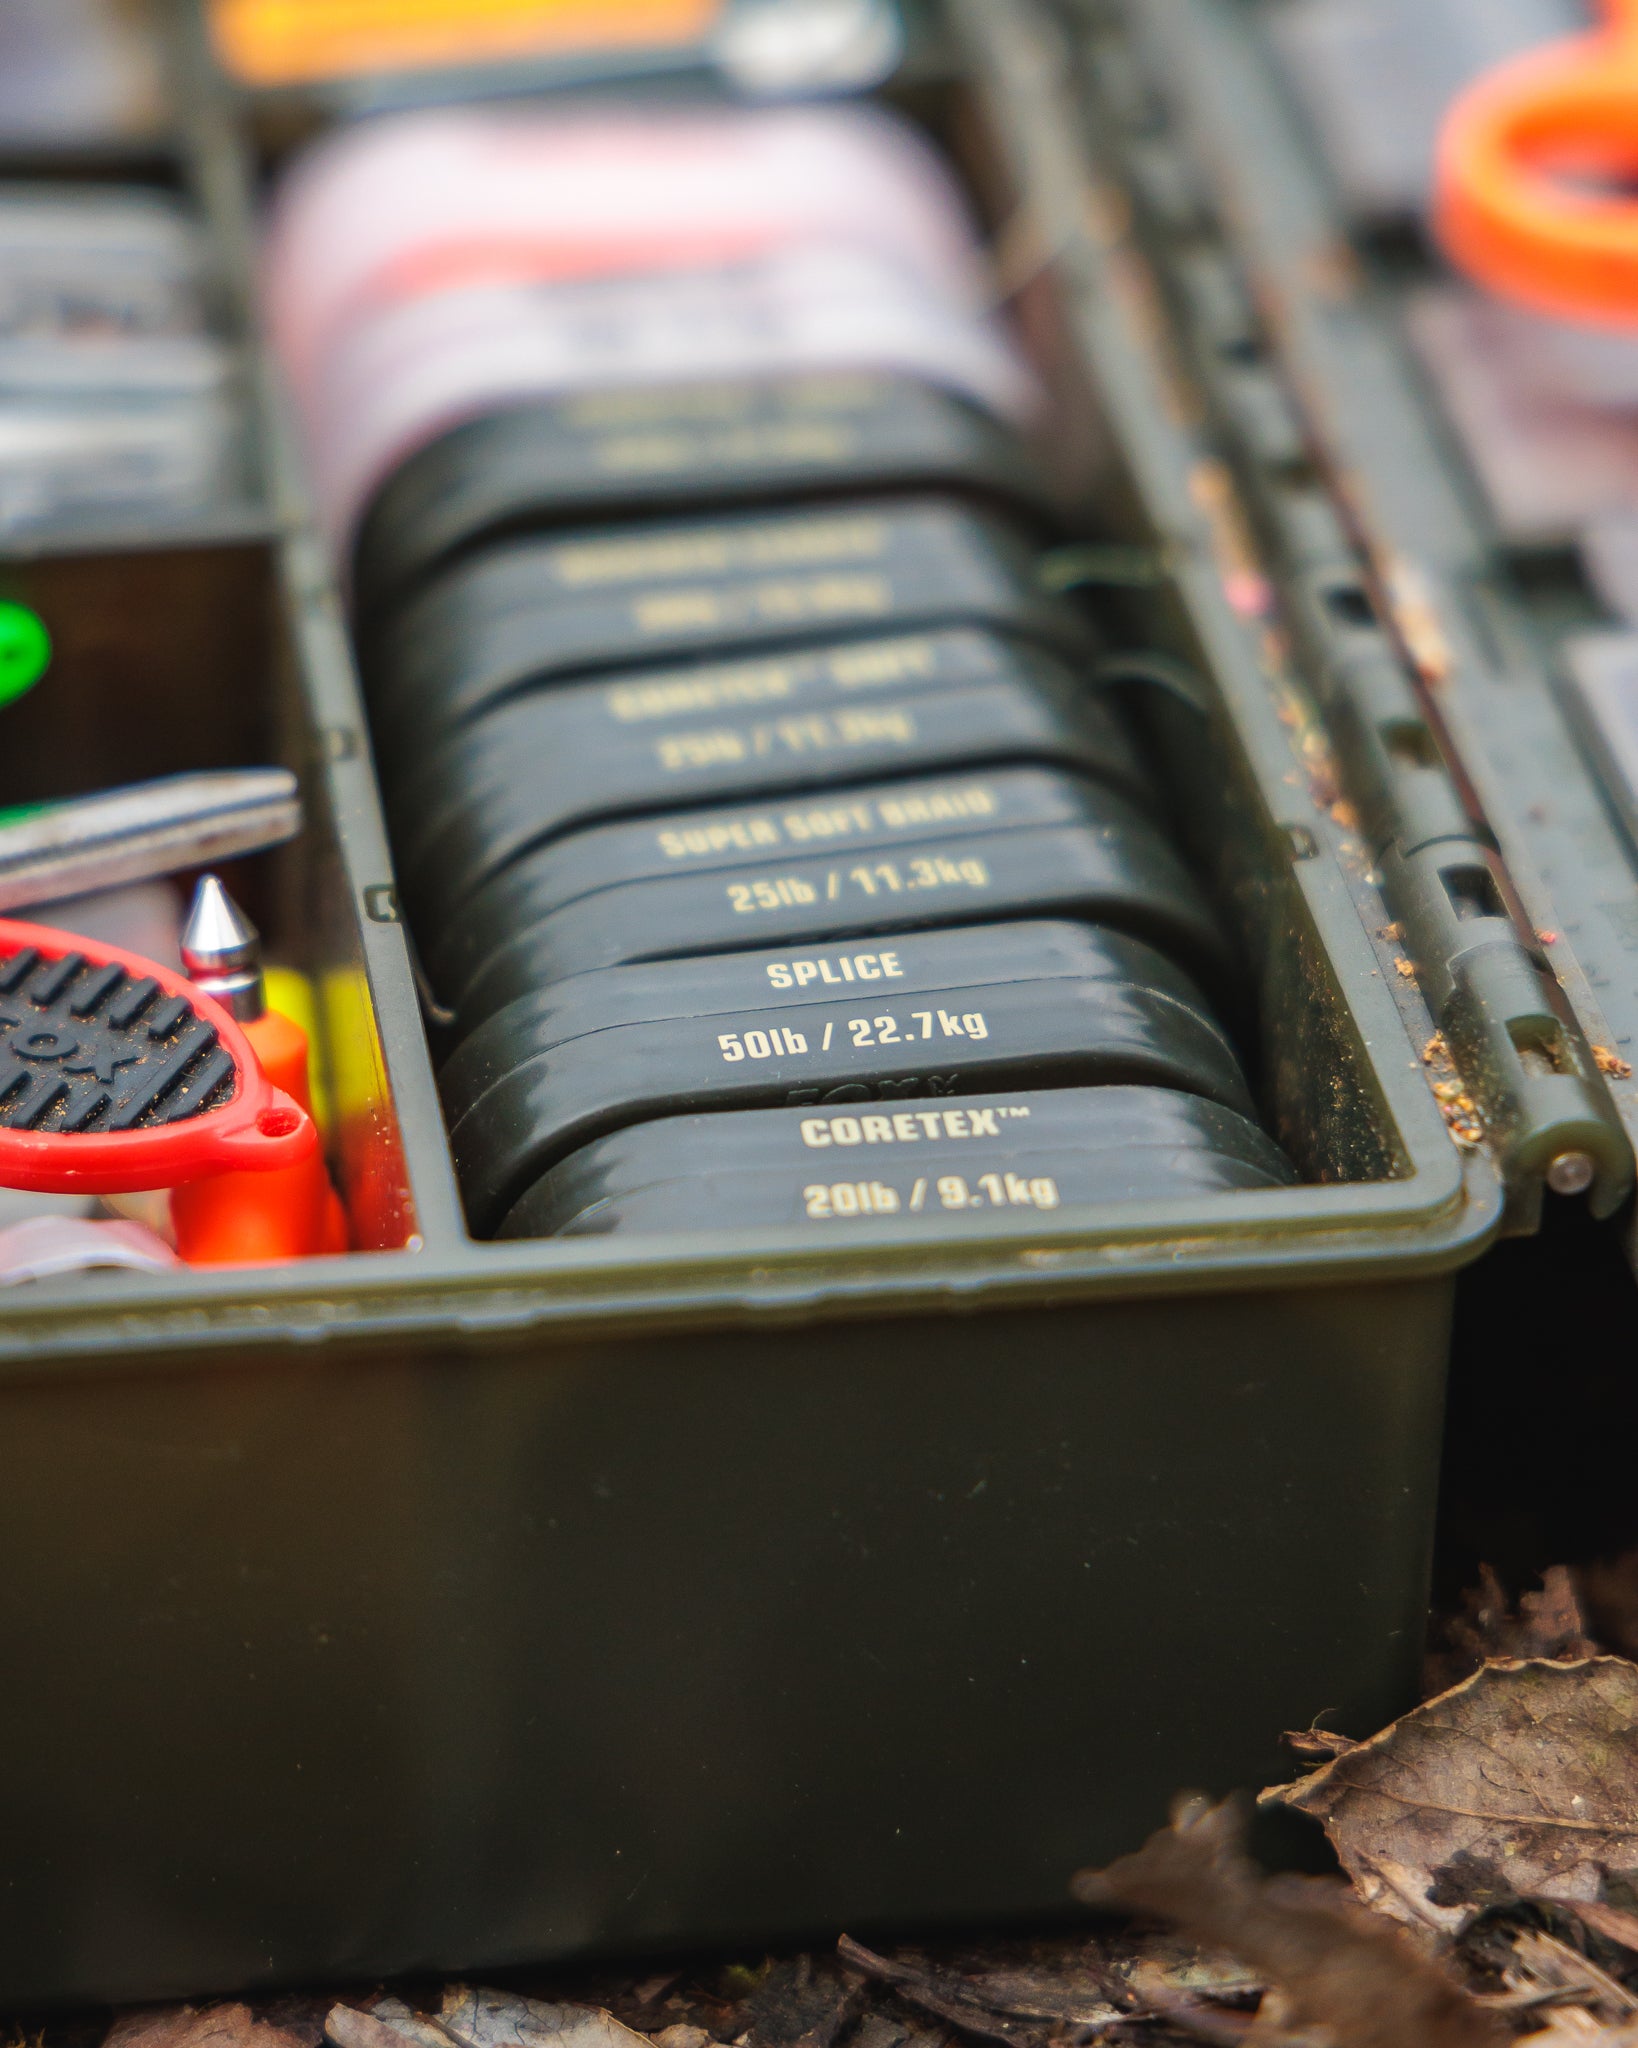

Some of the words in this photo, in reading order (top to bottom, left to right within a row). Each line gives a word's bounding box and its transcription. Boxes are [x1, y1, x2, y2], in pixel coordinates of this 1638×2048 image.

[658, 819, 776, 858] SUPER
[785, 803, 872, 843] SOFT
[878, 788, 995, 832] BRAID
[726, 876, 816, 915] 25lb
[825, 869, 840, 902] /
[850, 854, 988, 894] 11.3kg
[766, 953, 904, 988] SPLICE
[717, 1028, 808, 1062] 50lb
[822, 1022, 833, 1051] /
[848, 1010, 988, 1047] 22.7kg
[803, 1180, 900, 1219] 20lb
[909, 1178, 927, 1211] /
[937, 1172, 1059, 1210] 9.1kg
